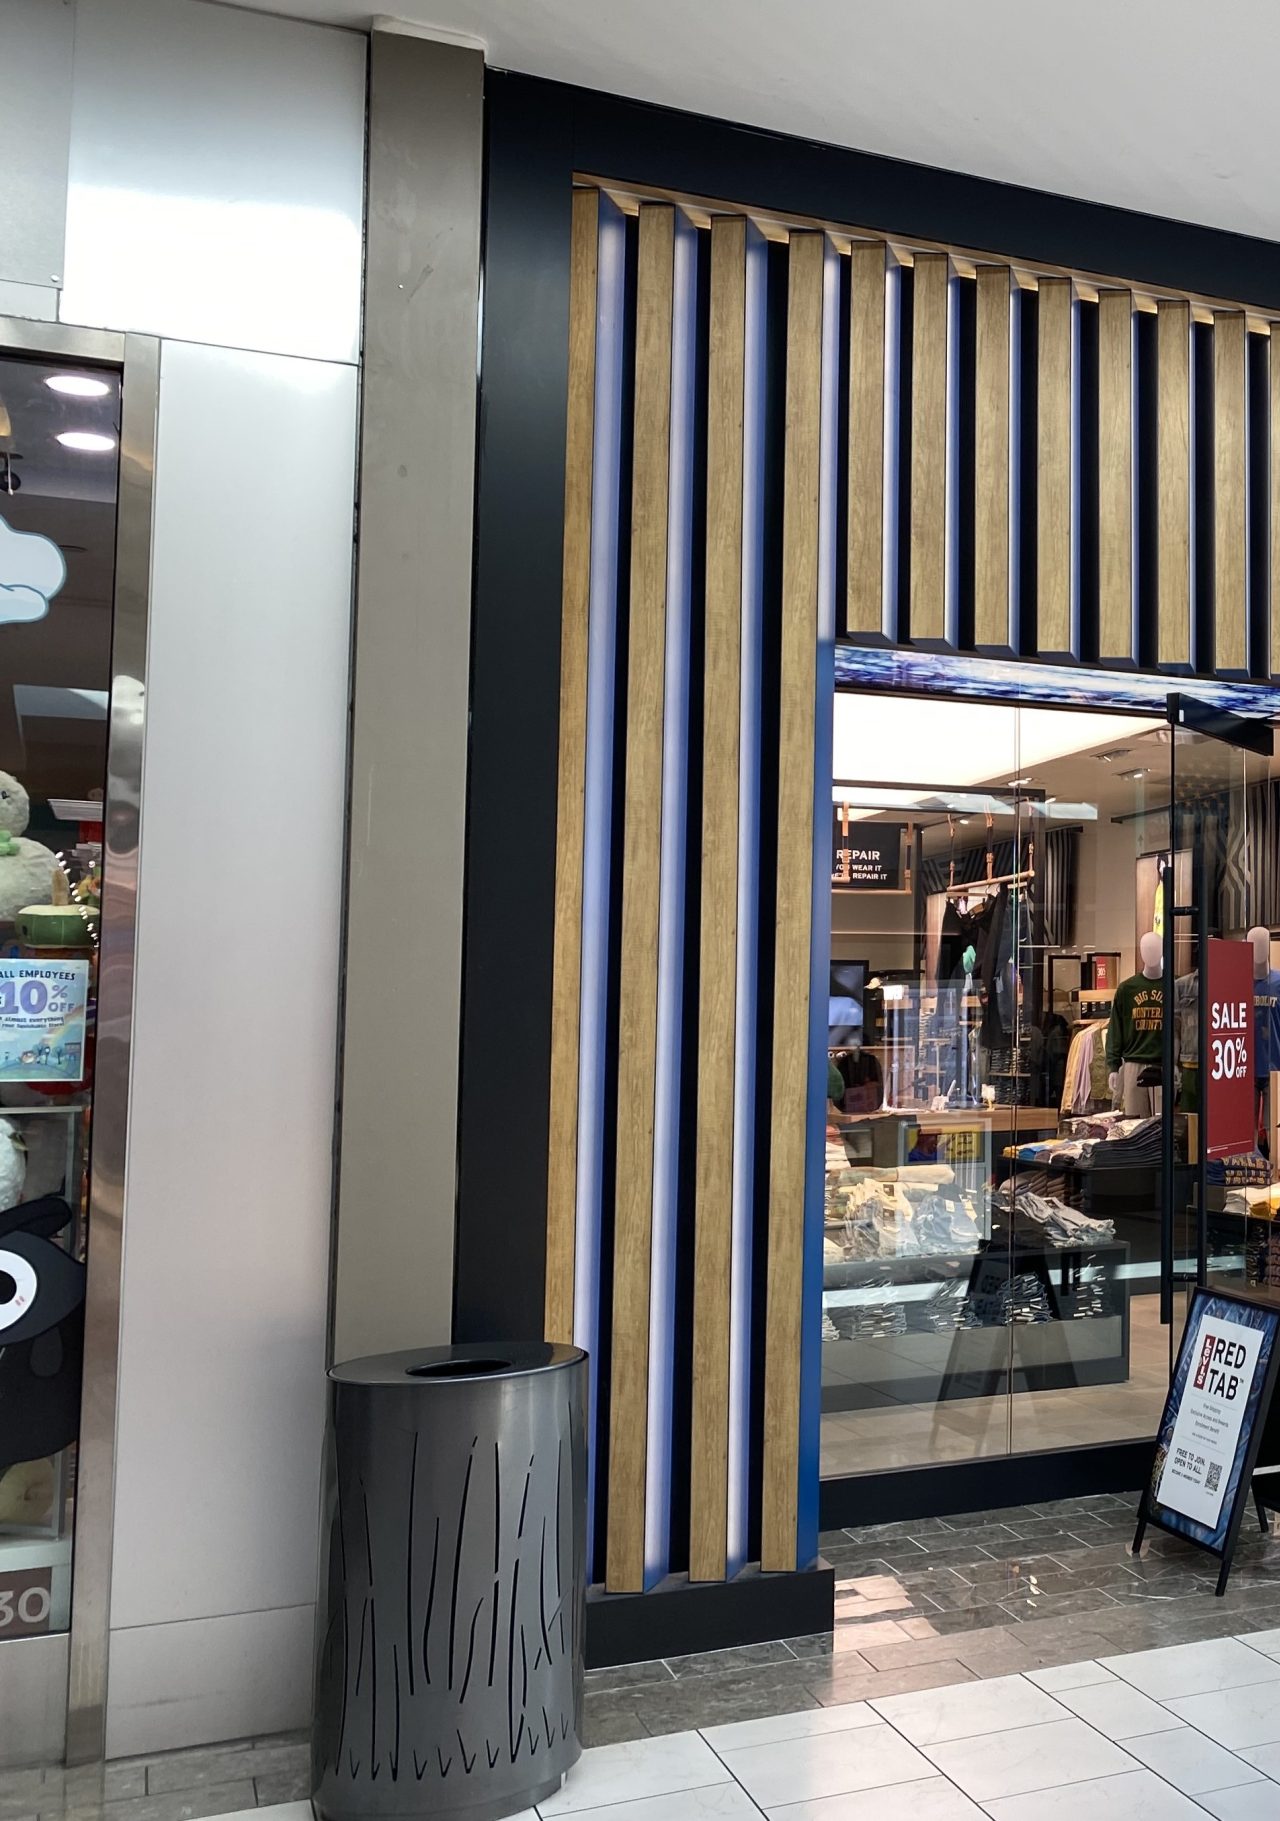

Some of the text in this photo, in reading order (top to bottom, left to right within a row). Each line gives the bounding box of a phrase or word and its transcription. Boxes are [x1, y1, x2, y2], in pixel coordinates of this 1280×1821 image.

[19, 970, 76, 981] EMPLOYEES
[1134, 989, 1164, 1006] BIG SU
[48, 1002, 75, 1013] OFF
[1211, 1002, 1247, 1030] SALE
[1235, 1066, 1247, 1078] OFF
[1212, 1338, 1247, 1369] RED
[1176, 1447, 1188, 1458] FREE
[1188, 1452, 1195, 1460] TO
[1174, 1457, 1186, 1468] OPEN
[1186, 1461, 1193, 1470] TO
